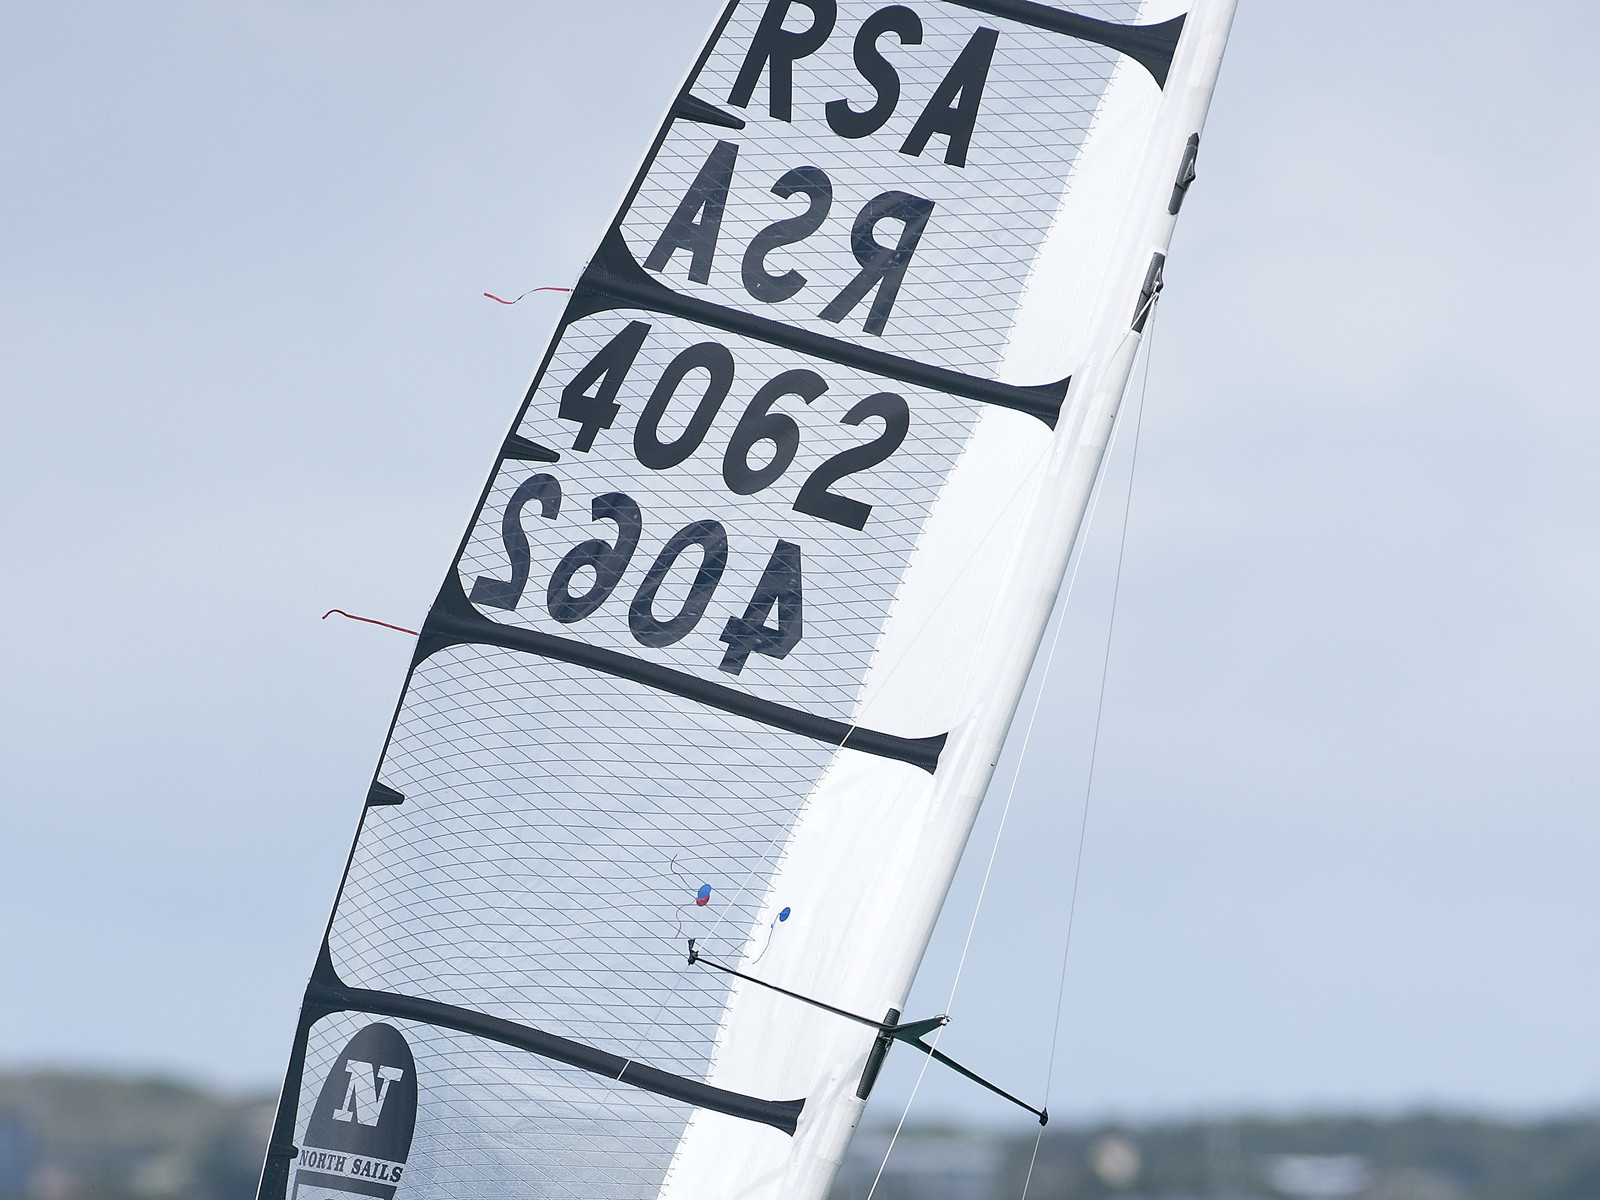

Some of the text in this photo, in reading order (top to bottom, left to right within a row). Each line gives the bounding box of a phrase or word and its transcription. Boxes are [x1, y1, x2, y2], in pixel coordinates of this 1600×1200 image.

[727, 0, 1000, 168] RSA
[557, 320, 910, 531] 4062
[332, 1059, 404, 1127] N
[299, 1149, 403, 1183] NORTH SAILS
